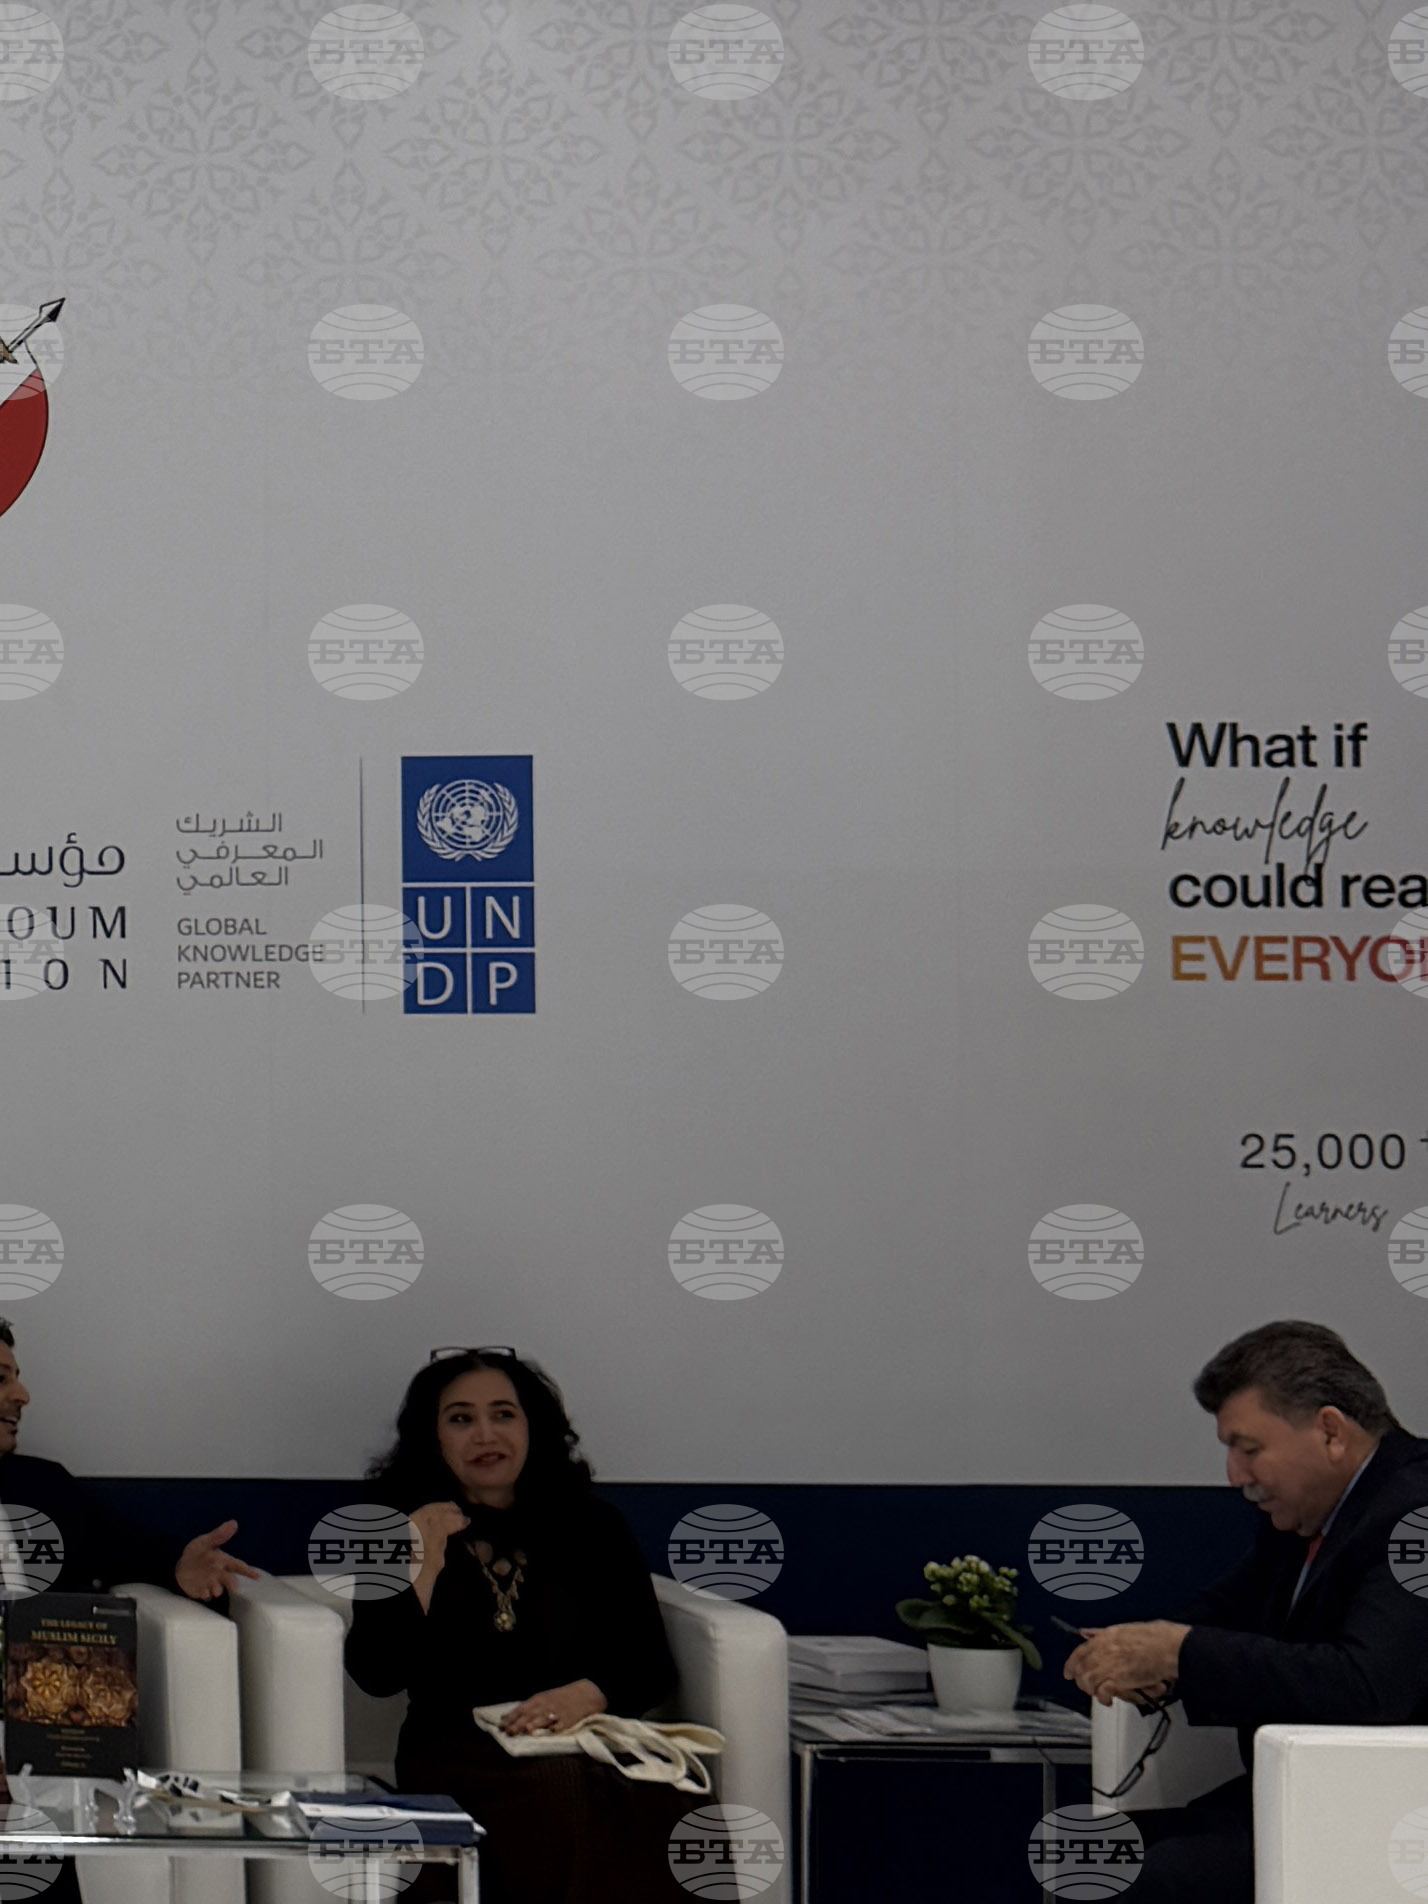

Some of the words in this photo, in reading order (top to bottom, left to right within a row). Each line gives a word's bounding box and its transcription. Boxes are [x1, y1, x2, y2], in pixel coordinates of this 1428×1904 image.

[1167, 722, 1317, 768] What
[1335, 722, 1368, 767] if
[176, 811, 282, 837] الشريك
[1161, 777, 1368, 886] knowledge
[176, 839, 323, 869] المعرفي
[176, 867, 288, 896] العالمي
[1169, 863, 1323, 908] could
[177, 918, 267, 936] GLOBAL
[178, 944, 324, 962] KNOWLEDGE
[1171, 936, 1428, 982] EVERYO
[178, 971, 280, 989] PARTNER
[1241, 1133, 1405, 1176] 25,000
[1274, 1182, 1388, 1235] Learners
